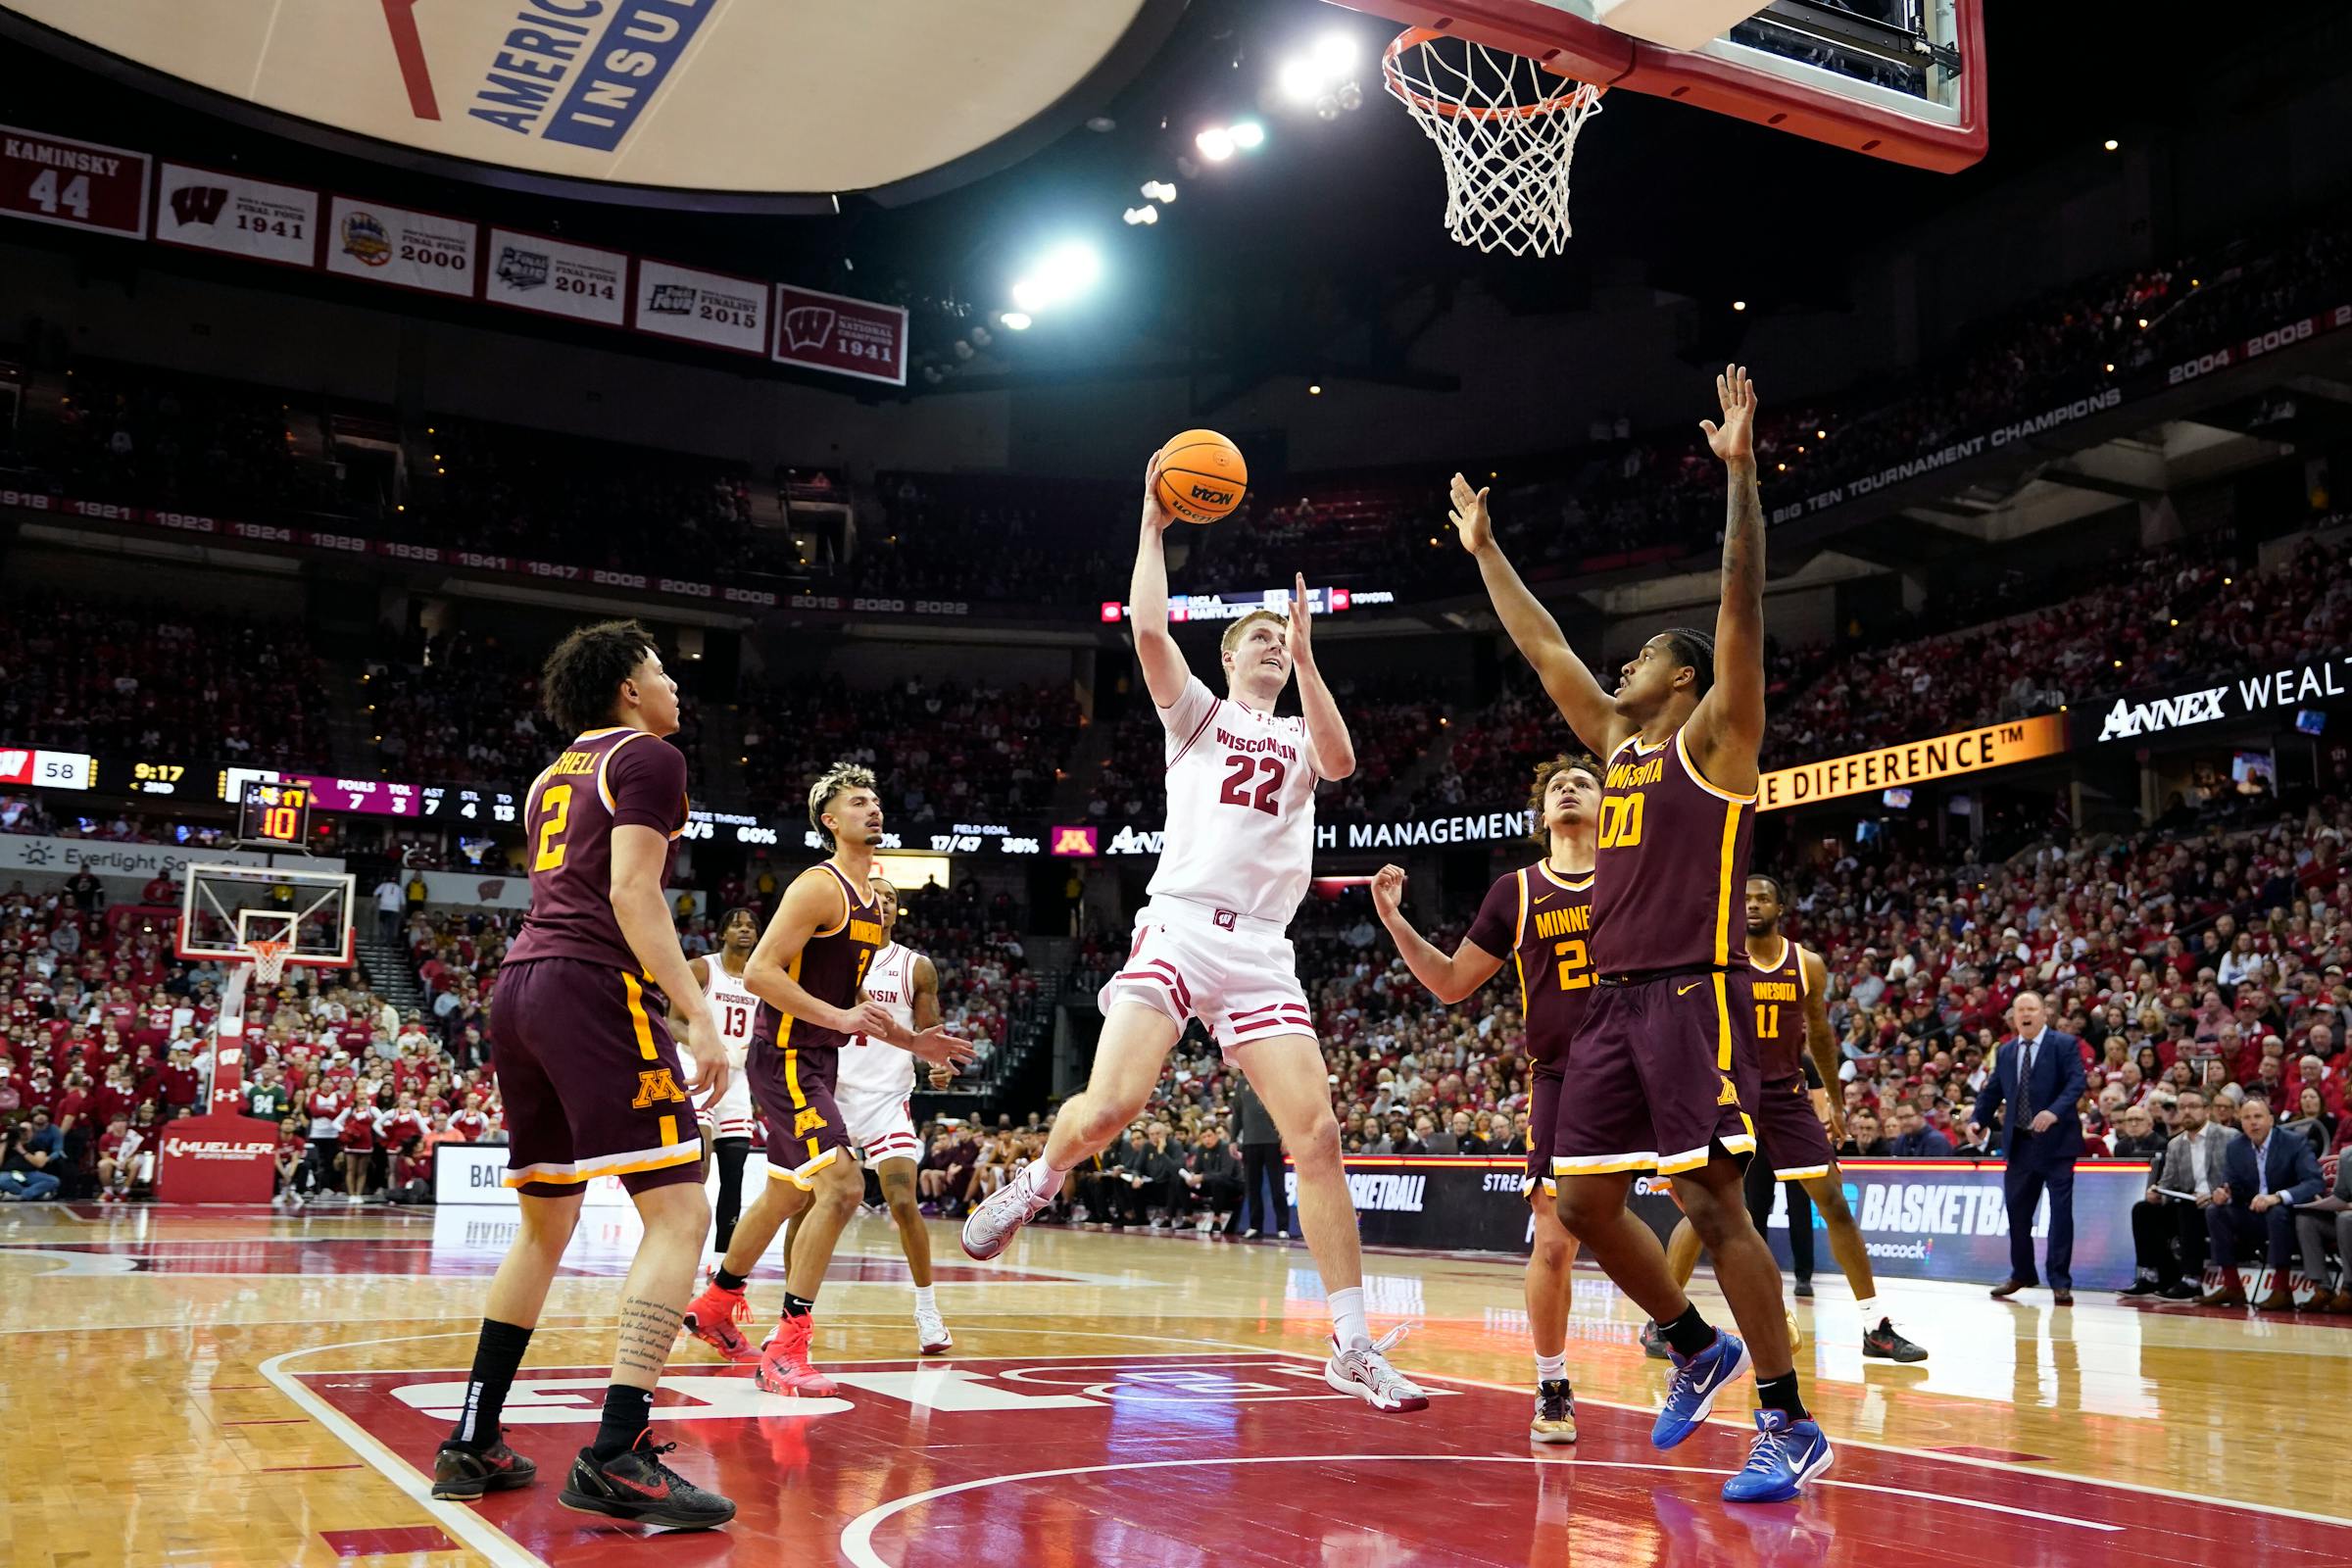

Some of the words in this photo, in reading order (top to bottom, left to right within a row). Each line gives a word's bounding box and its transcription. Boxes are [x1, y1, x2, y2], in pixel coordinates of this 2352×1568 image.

[571, 0, 686, 129] INSU
[4, 138, 120, 176] KAMINSKY
[28, 168, 90, 219] 44
[236, 215, 304, 239] 1941
[399, 245, 466, 270] 2000
[555, 276, 614, 300] 2014
[700, 305, 757, 328] 2015
[838, 338, 892, 362] 1941
[2169, 348, 2230, 385] 2004
[2247, 318, 2313, 357] 2008
[1772, 503, 1802, 525] BIG
[1805, 488, 1842, 511] TEN
[1847, 435, 1986, 497] TOURNAMENT
[1990, 387, 2122, 447] CHAMPIONS
[1191, 485, 1235, 505] NCAA
[0, 489, 48, 510] 918
[74, 500, 131, 520] 1921
[155, 512, 215, 532] 1923
[235, 522, 291, 541] 1924
[385, 542, 439, 562] 1935
[458, 552, 508, 569] 1941
[527, 562, 579, 579] 1947
[593, 569, 647, 589] 2002
[660, 578, 711, 597] 2003
[854, 597, 905, 612] 2020
[914, 600, 968, 614] 2022
[2097, 686, 2229, 742] ANNEX
[2239, 657, 2352, 711] WEAL
[45, 762, 74, 779] 58
[134, 762, 184, 781] 9:17
[336, 779, 376, 793] FOULS
[422, 788, 446, 798] AST
[461, 790, 481, 802] STL
[496, 794, 513, 804] TO
[1219, 755, 1285, 816] 22
[349, 794, 365, 809] 7
[391, 797, 407, 813] 3
[424, 799, 440, 815] 7
[461, 803, 477, 818] 4
[688, 810, 712, 822] FREE
[714, 813, 757, 825] THROWS
[264, 808, 296, 839] 10
[534, 784, 572, 872] 2
[953, 823, 982, 834] FIELD
[1349, 809, 1536, 848] MANAGEMENT
[1598, 792, 1645, 850] 00
[737, 826, 777, 845] 60%
[930, 834, 982, 852] 17/47
[1105, 825, 1165, 855] ANN
[65, 848, 157, 871] Everlight
[1535, 905, 1592, 939] MINNE
[1554, 939, 1599, 991] 2
[714, 992, 756, 1006] WISCONSIN
[723, 1006, 746, 1038] 13
[1755, 1004, 1779, 1038] 11
[253, 1094, 274, 1114] 84
[179, 1141, 275, 1154] MUELLER
[1345, 1174, 1426, 1212] SKETBALL
